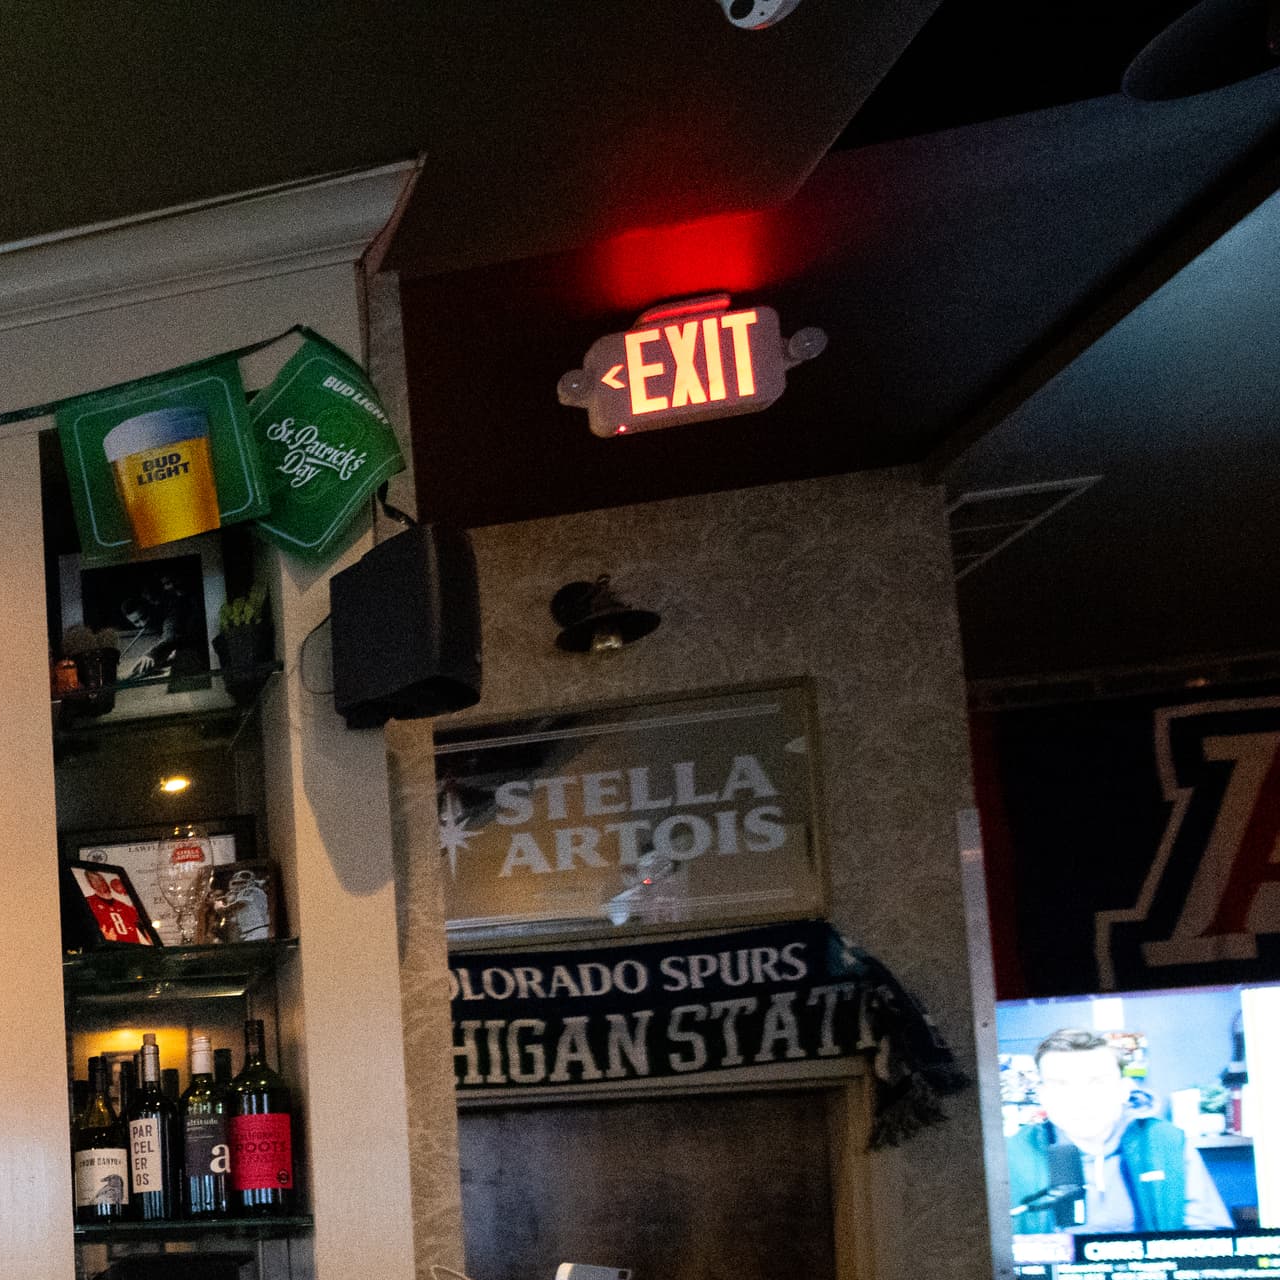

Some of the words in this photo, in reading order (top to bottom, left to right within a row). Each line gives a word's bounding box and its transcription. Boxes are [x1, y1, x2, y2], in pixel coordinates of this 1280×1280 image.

[624, 310, 758, 415] EXIT
[322, 375, 354, 396] BUD
[351, 390, 390, 425] LIGHT
[142, 453, 181, 472] BUD
[267, 418, 298, 445] St.
[289, 425, 368, 481] Patrick's
[137, 462, 190, 486] LIGHT
[277, 450, 322, 488] Day
[495, 755, 779, 826] STELLA
[498, 805, 788, 879] ARTOIS
[660, 942, 808, 992] SPURS
[132, 1124, 153, 1138] PAR
[133, 1141, 155, 1154] CEL
[135, 1157, 148, 1171] ER
[135, 1172, 150, 1187] OS
